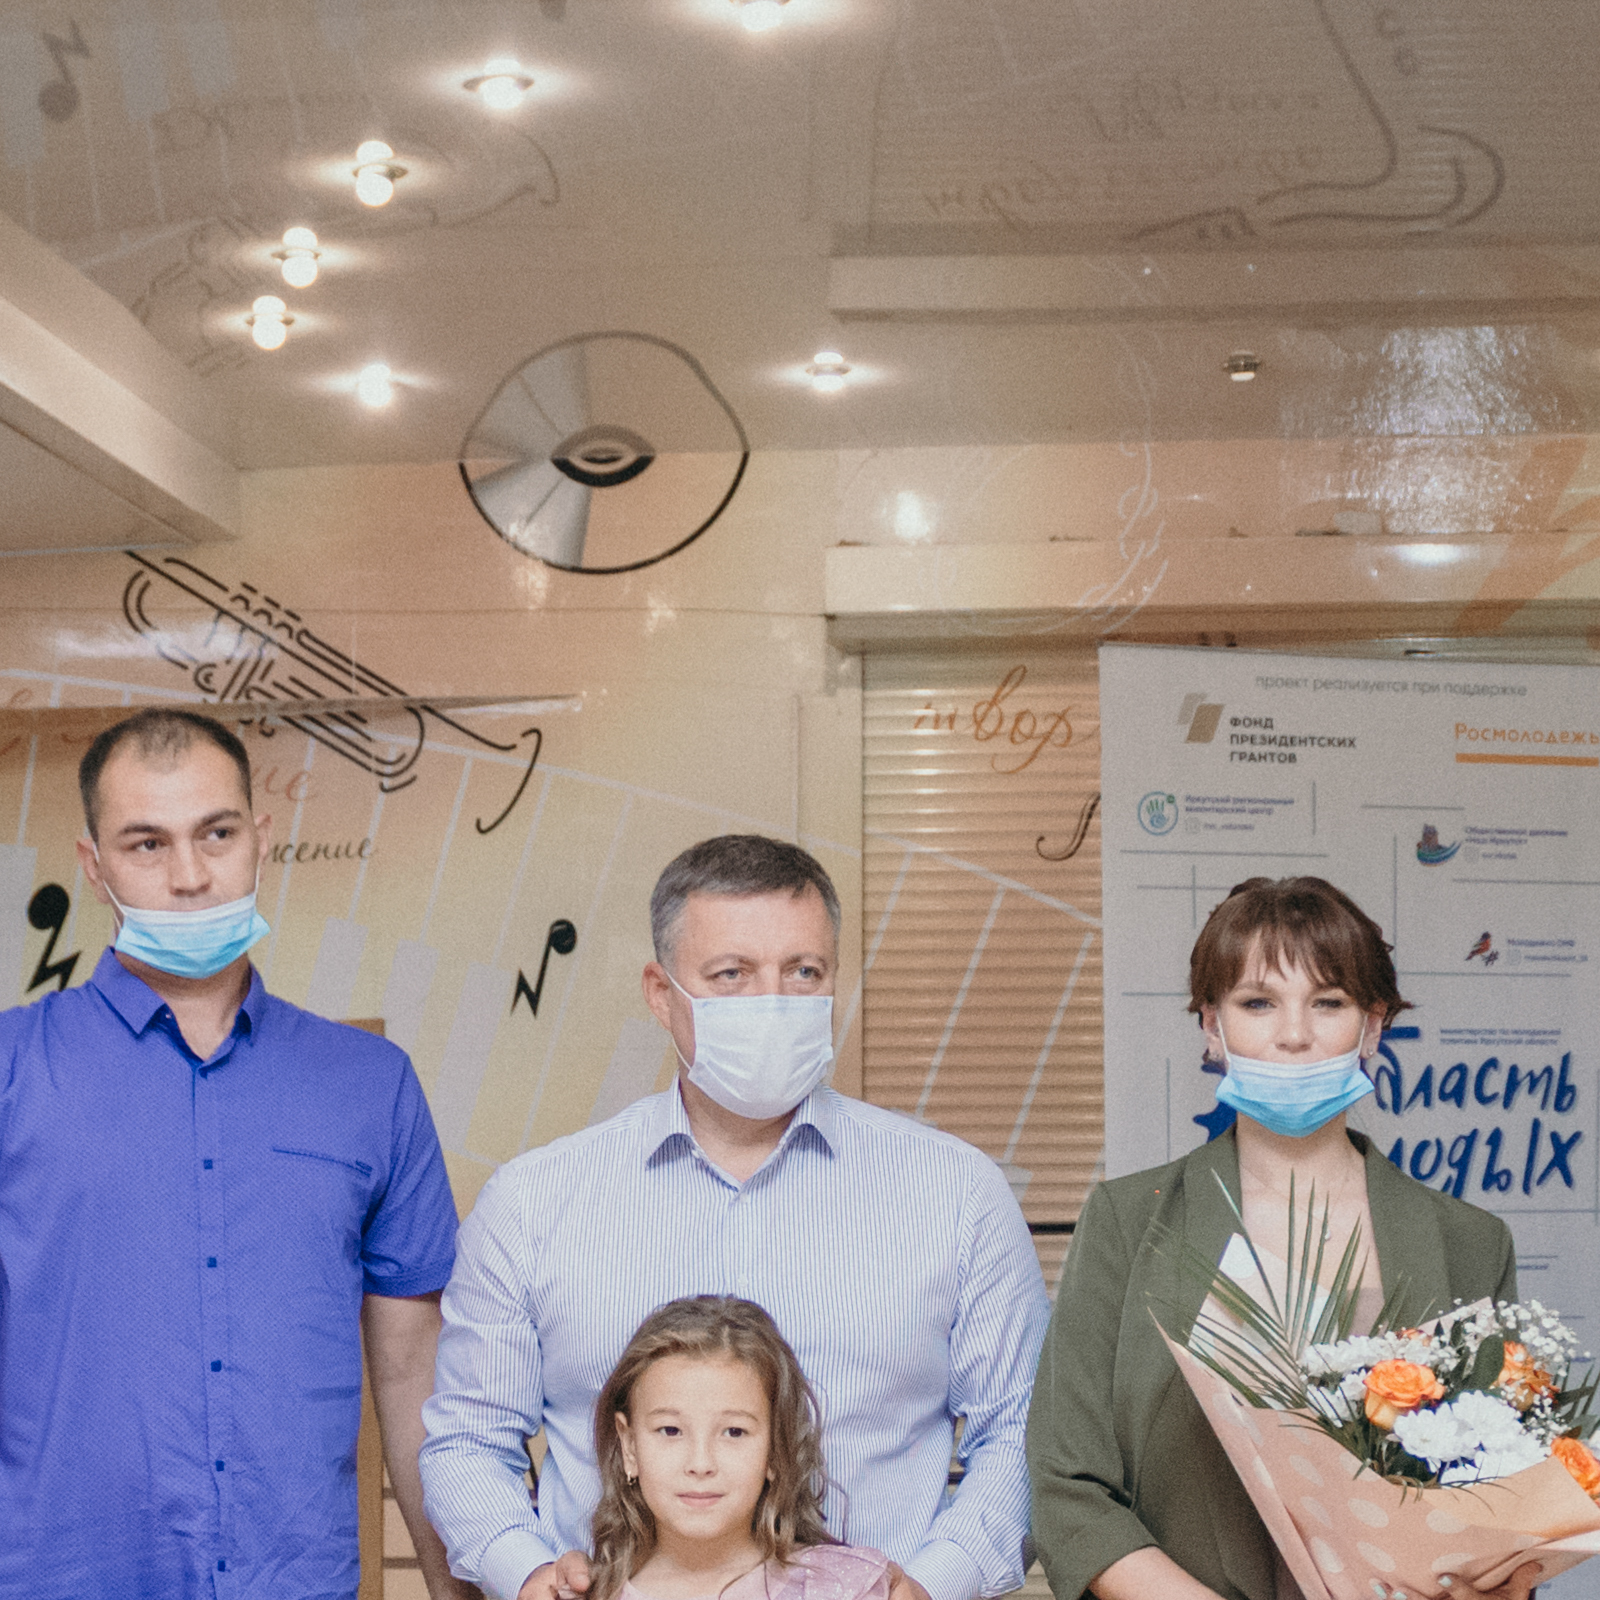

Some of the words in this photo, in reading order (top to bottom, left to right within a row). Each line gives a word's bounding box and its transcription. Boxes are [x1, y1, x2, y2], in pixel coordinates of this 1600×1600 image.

[1255, 675, 1308, 690] проект
[1312, 677, 1409, 694] реализуется
[1412, 681, 1440, 695] при
[1444, 682, 1528, 697] поддержке
[1230, 716, 1274, 730] ФОНД
[1230, 733, 1357, 749] ПРЕЗИДЕНТСКИХ
[1230, 751, 1298, 765] ГРАНТОВ
